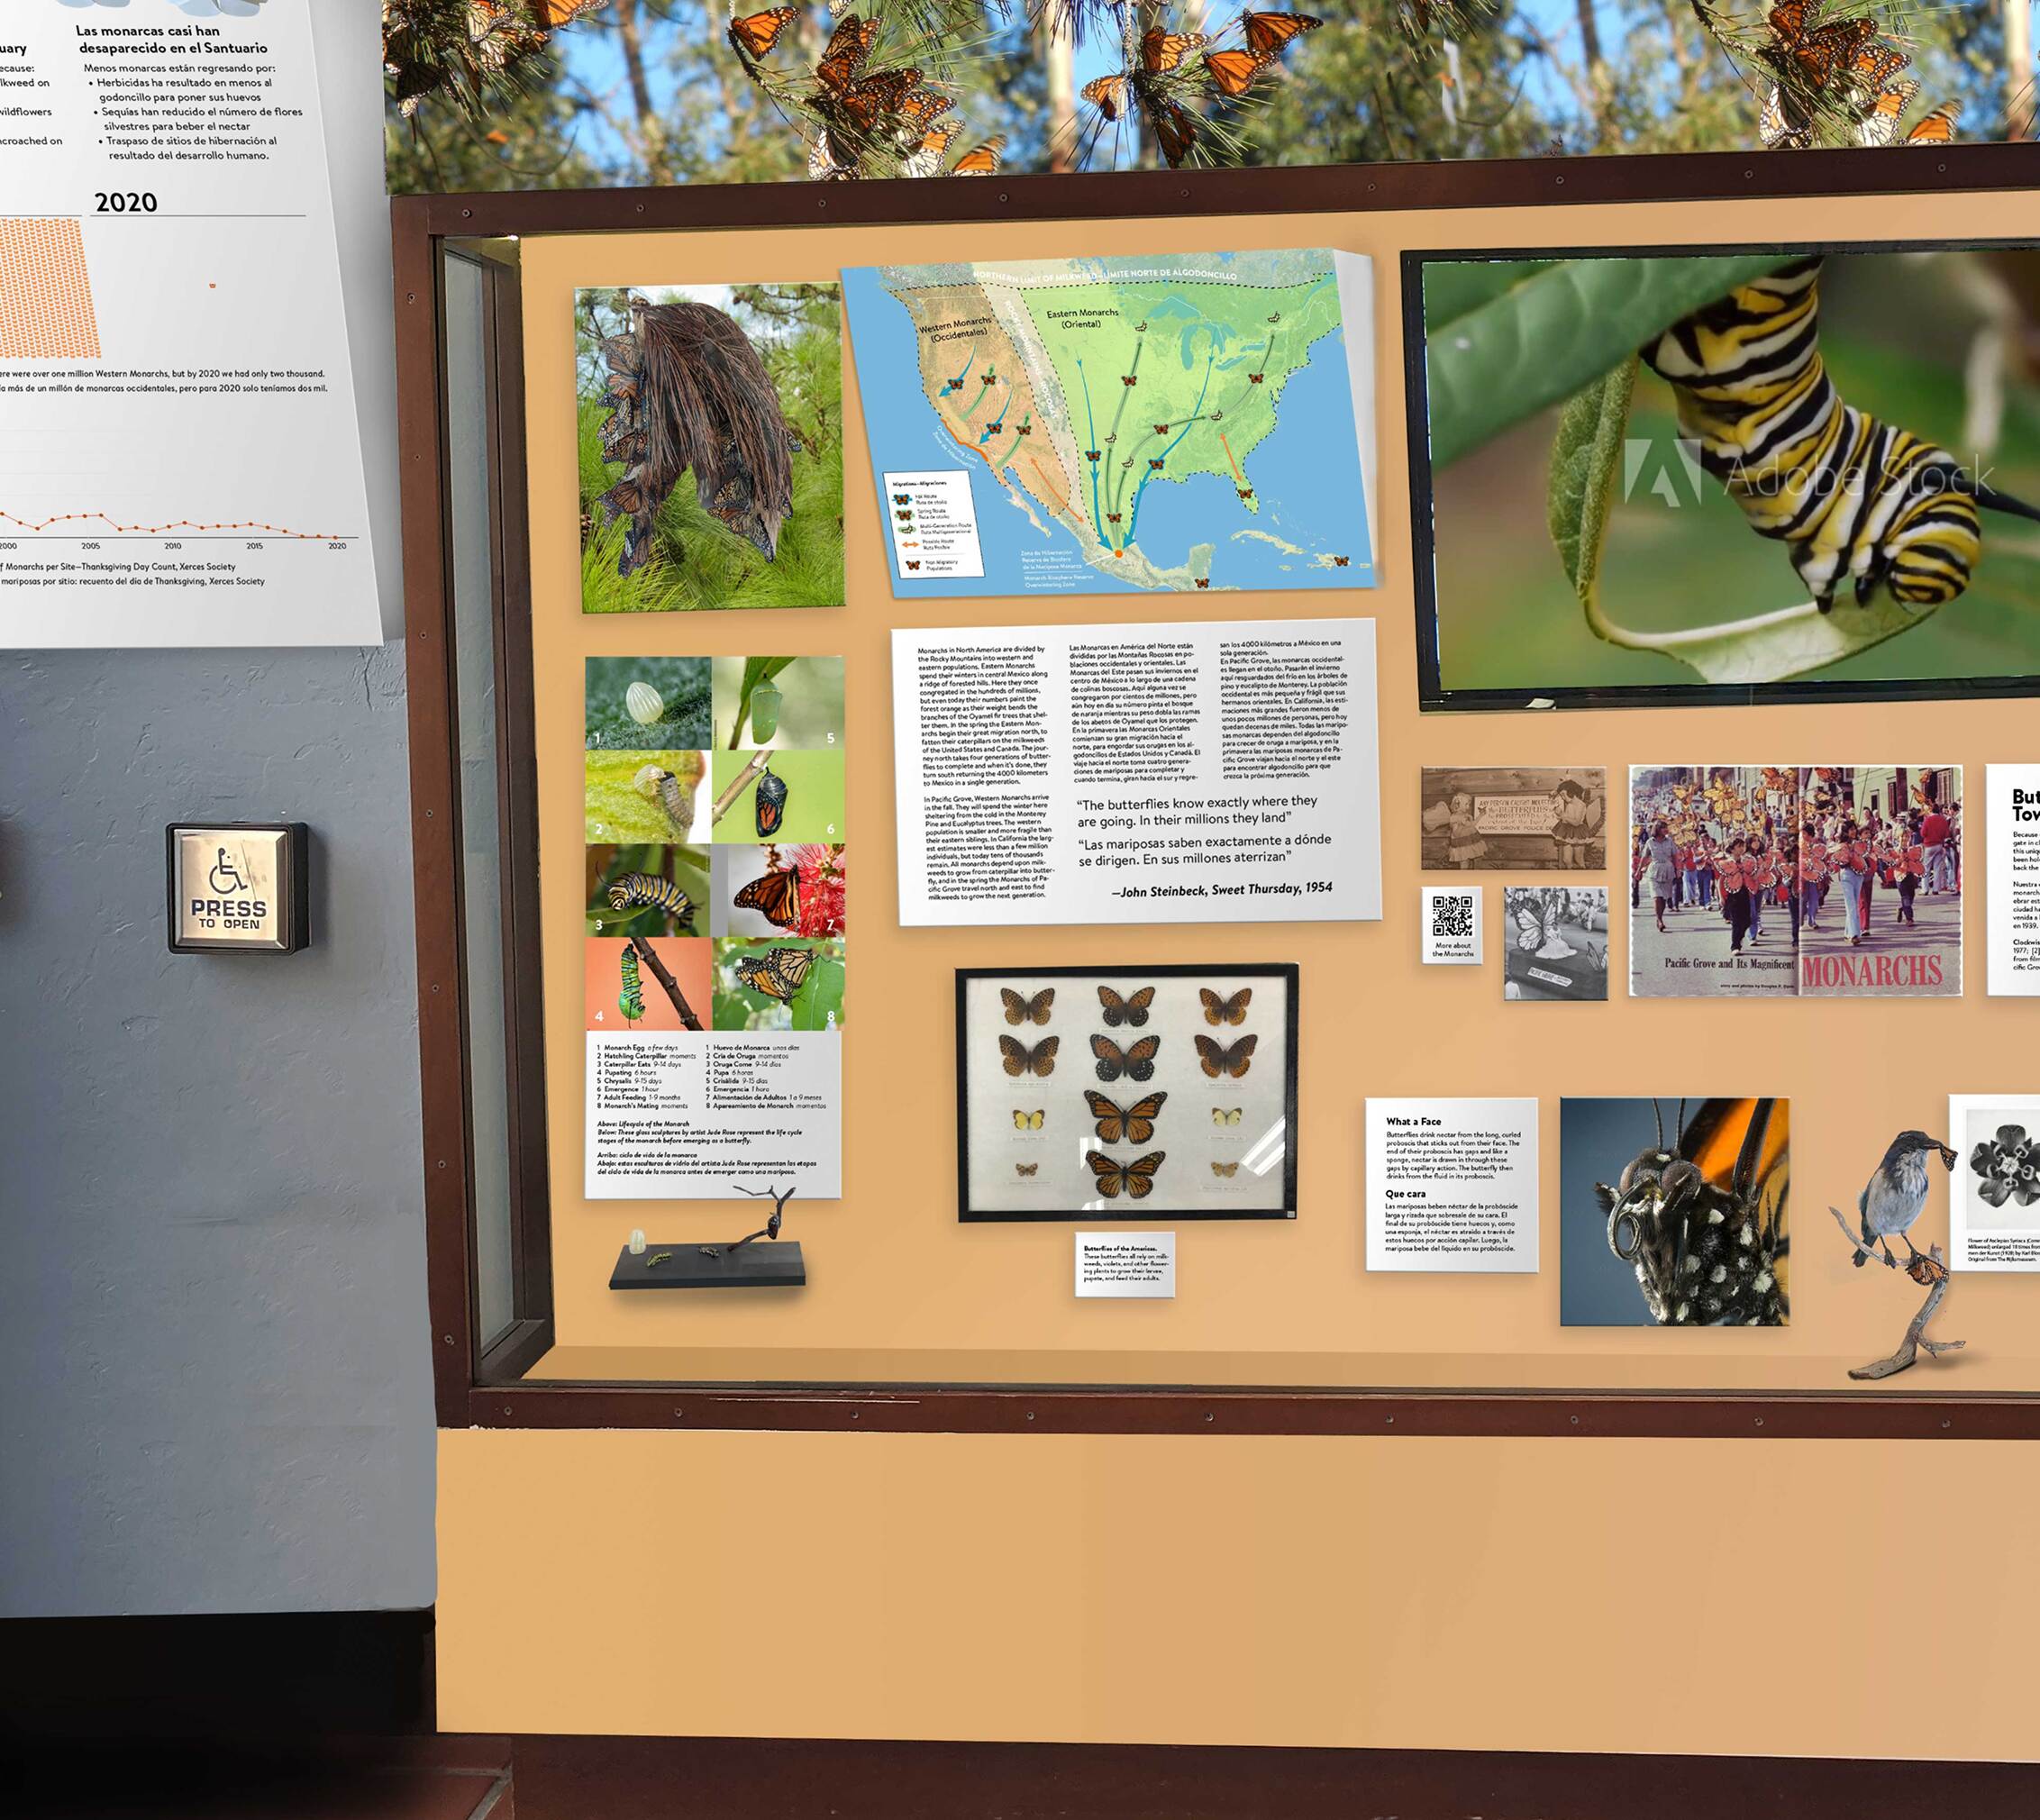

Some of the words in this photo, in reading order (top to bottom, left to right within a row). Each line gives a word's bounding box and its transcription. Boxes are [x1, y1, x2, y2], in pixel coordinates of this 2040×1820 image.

[76, 24, 98, 36] Las
[101, 28, 164, 36] monarcas
[168, 24, 192, 36] casi
[195, 24, 220, 36] han
[79, 41, 167, 57] desaparecido
[169, 45, 186, 53] en
[189, 41, 201, 53] el
[204, 41, 268, 53] Santuario
[84, 63, 117, 72] Menos
[168, 63, 196, 72] están
[197, 63, 253, 75] regresando
[255, 66, 276, 75] por:
[96, 77, 150, 86] Herbicidas
[150, 77, 163, 86] ha
[165, 77, 212, 86] resultado
[264, 77, 272, 86] al
[99, 92, 151, 104] godoncillo
[153, 95, 175, 104] para
[177, 95, 206, 104] poner
[225, 92, 261, 101] huevos
[101, 106, 139, 118] Sequías
[141, 107, 159, 115] han
[161, 106, 205, 116] reducido
[207, 106, 216, 116] el
[219, 107, 257, 116] número
[259, 107, 272, 115] de
[274, 106, 303, 116] flores
[105, 135, 149, 147] Traspaso
[150, 136, 164, 145] de
[166, 136, 192, 145] sitios
[193, 136, 206, 145] de
[208, 136, 267, 145] hibernación
[269, 136, 277, 145] al
[95, 192, 157, 212] 2020
[973, 271, 1018, 283] NORTHERN
[1019, 276, 1042, 284] LIMIT
[1043, 274, 1053, 282] OF
[1131, 269, 1158, 278] NORTE
[1160, 268, 1170, 277] DE
[1172, 268, 1237, 280] ALGODONCILLO
[1046, 310, 1078, 319] Eastern
[1079, 308, 1119, 316] Monarchs
[918, 323, 952, 334] Western
[953, 316, 992, 328] Monarchs
[1061, 319, 1101, 329] (Oriental)
[930, 326, 988, 343] (Occidentales)
[81, 541, 101, 550] 2005
[164, 541, 182, 550] 2010
[246, 541, 263, 550] 2015
[328, 541, 347, 550] 2020
[5, 562, 44, 570] Monarchs
[45, 564, 59, 572] per
[132, 561, 150, 572] Day
[151, 562, 178, 571] Count,
[179, 562, 205, 570] Xerces
[205, 562, 236, 572] Society
[1036, 645, 1045, 653] by
[596, 733, 600, 743] 1
[827, 733, 834, 743] 5
[1107, 797, 1170, 810] butterflies
[1172, 797, 1204, 808] know
[1207, 796, 1250, 810] exactly
[1252, 795, 1289, 806] where
[1290, 794, 1318, 808] they
[1078, 818, 1097, 827] are
[1099, 815, 1136, 829] going.
[1139, 814, 1151, 825] In
[1153, 814, 1181, 825] their
[1184, 813, 1230, 824] millions
[1232, 812, 1259, 826] they
[596, 824, 602, 834] 2
[827, 824, 834, 834] 6
[1107, 838, 1165, 852] mariposas
[1168, 837, 1202, 848] saben
[1205, 835, 1282, 847] exactamente
[1284, 837, 1291, 845] a
[1294, 833, 1332, 845] dónde
[1079, 858, 1092, 867] se
[1095, 854, 1140, 869] dirigen.
[1143, 853, 1158, 865] En
[1161, 856, 1179, 864] sus
[1182, 852, 1231, 863] millones
[1150, 885, 1208, 897] Steinbeck,
[1211, 884, 1245, 895] Sweet
[1248, 882, 1302, 896] Thursday,
[1306, 881, 1333, 893] 1954
[191, 899, 267, 917] PRESS
[198, 917, 215, 928] TO
[223, 919, 260, 929] OPEN
[596, 920, 603, 930] 3
[827, 920, 834, 930] 7
[2023, 922, 2038, 930] 1939.
[1664, 957, 1690, 968] Pacific
[1692, 957, 1716, 969] Grove
[1717, 958, 1733, 968] and
[1736, 958, 1748, 969] Its
[1750, 959, 1795, 971] Magnificent
[1803, 955, 1943, 987] MONARCHS
[595, 1011, 604, 1021] 4
[827, 1011, 835, 1022] 8
[633, 1043, 645, 1052] Egg
[604, 1060, 636, 1069] Caterpillar
[1386, 1117, 1410, 1125] What
[1421, 1116, 1442, 1125] Face
[1485, 1131, 1501, 1140] long,
[1385, 1189, 1405, 1200] Que
